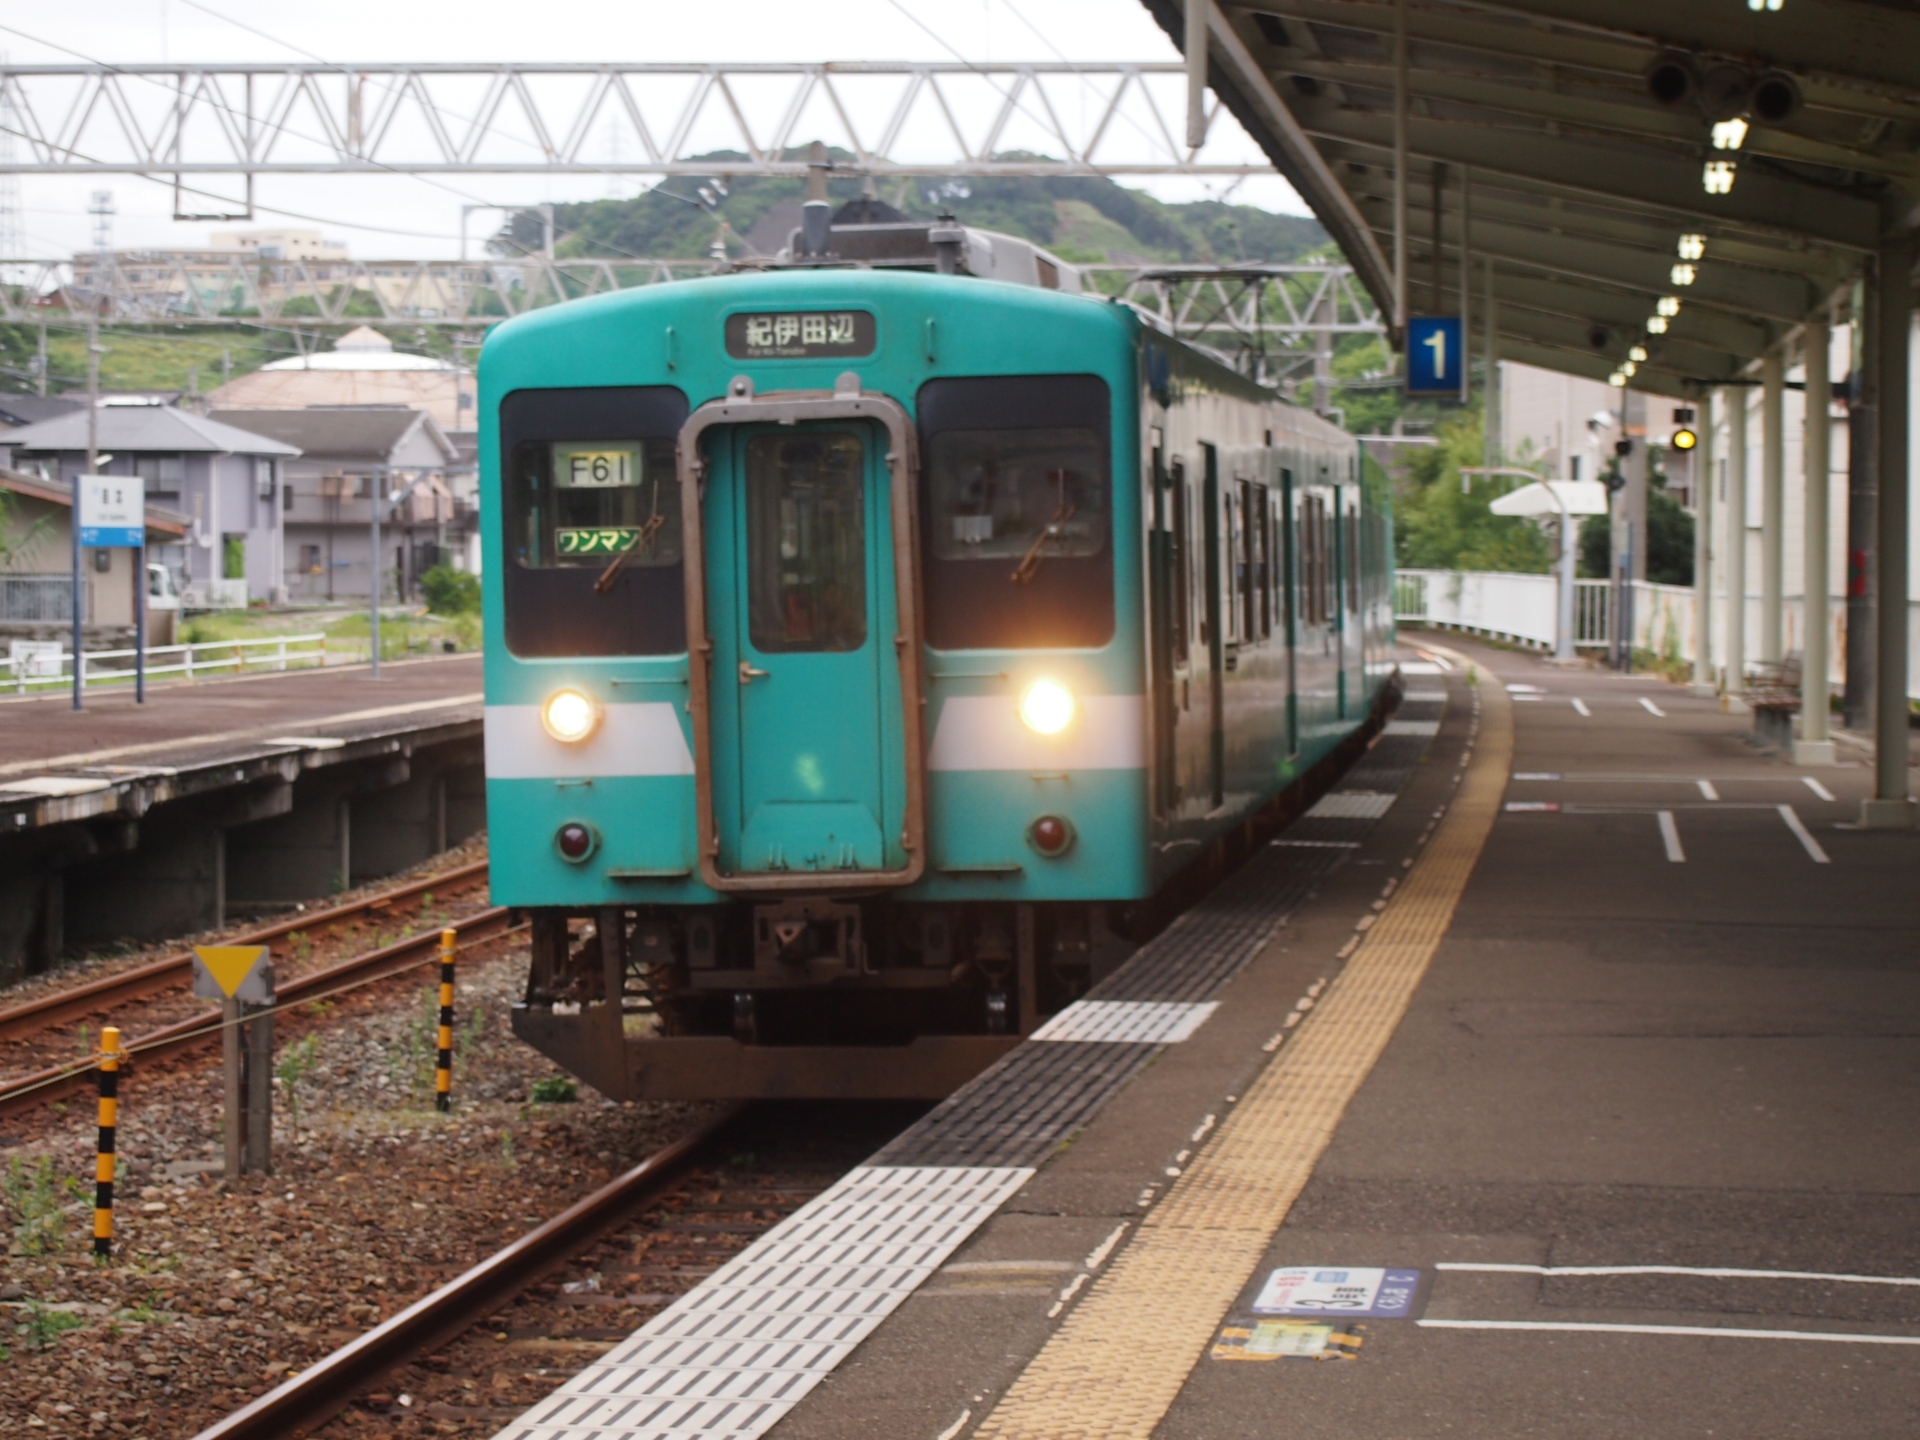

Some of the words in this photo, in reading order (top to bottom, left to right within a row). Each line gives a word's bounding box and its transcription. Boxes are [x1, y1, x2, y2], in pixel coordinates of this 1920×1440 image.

[746, 315, 854, 346] 紀伊田辺
[1422, 329, 1445, 379] 1
[559, 531, 639, 552] ワンマン
